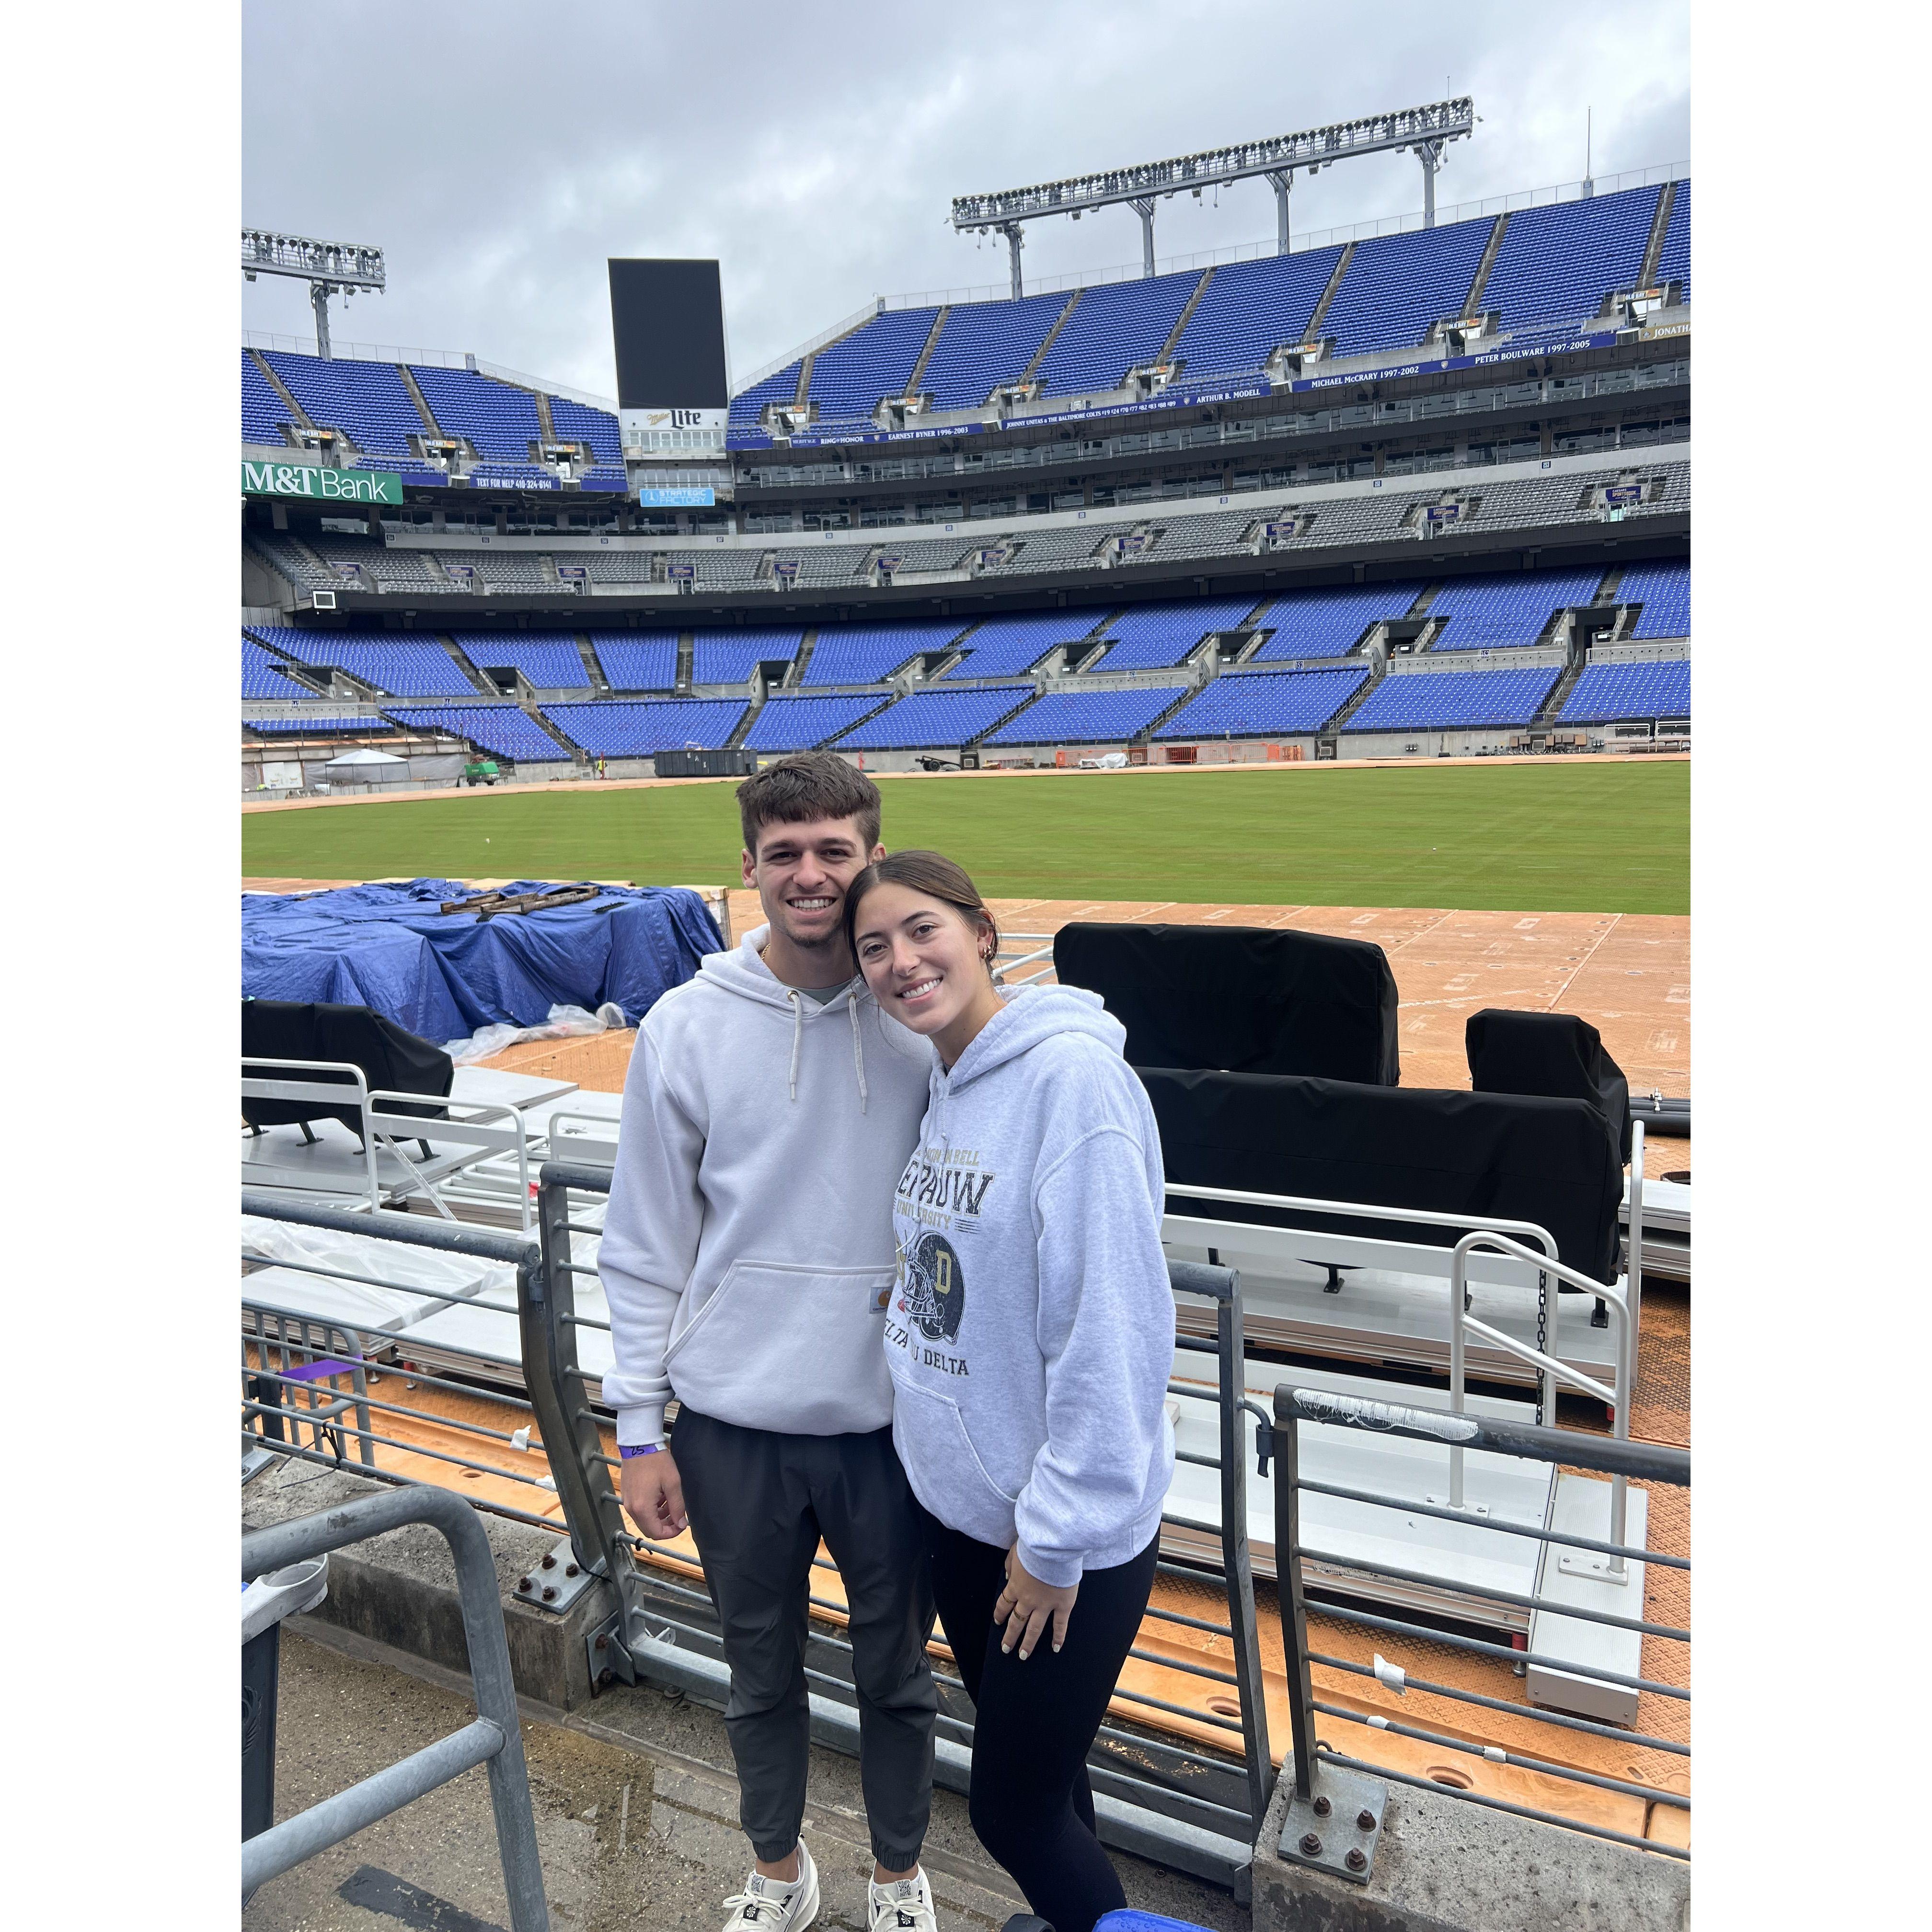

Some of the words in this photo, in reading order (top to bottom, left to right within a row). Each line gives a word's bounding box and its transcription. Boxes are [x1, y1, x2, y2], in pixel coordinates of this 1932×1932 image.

[1475, 354, 1499, 364] PETER
[1501, 347, 1545, 360] BOULWARE
[1548, 339, 1590, 354] 1997-2005
[1311, 378, 1343, 388] MICHAEL
[1380, 366, 1419, 379] 1997-2002
[1196, 394, 1223, 403] ARTHUR
[1233, 389, 1261, 399] MODELL
[647, 413, 670, 426] Miller
[670, 410, 701, 429] Lite
[1006, 421, 1026, 429] JOHNNY
[1058, 413, 1086, 422] BALTIMORE
[937, 427, 968, 436] 1996-2003
[242, 462, 317, 495] M&T
[320, 469, 388, 502] Bank
[476, 478, 489, 487] TEXT
[490, 479, 501, 488] FOR
[954, 1149, 980, 1166] BELL
[895, 1159, 995, 1218] EPAUW
[897, 1199, 951, 1230] UNIERSITY
[935, 1249, 952, 1294] D
[924, 1349, 969, 1376] DELTA
